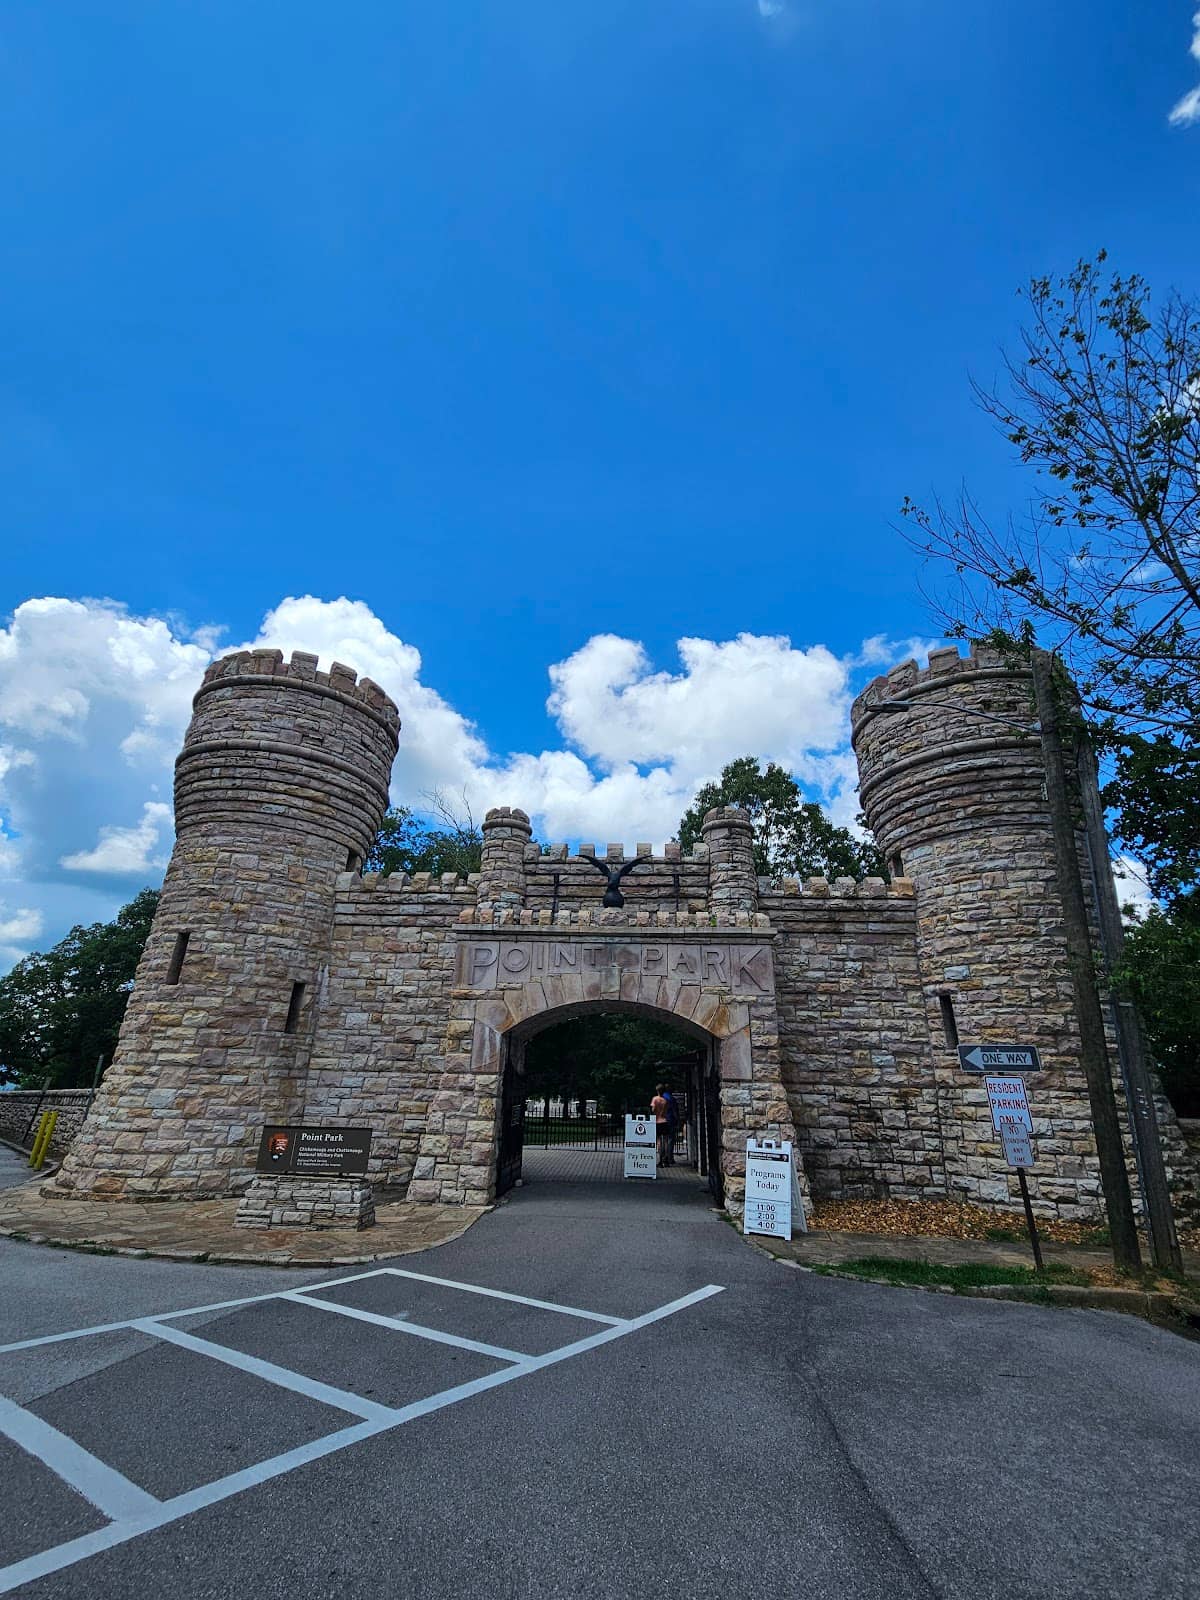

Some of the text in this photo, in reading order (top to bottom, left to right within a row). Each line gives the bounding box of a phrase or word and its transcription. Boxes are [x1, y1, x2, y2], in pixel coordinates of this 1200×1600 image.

[468, 943, 770, 992] POINT PARK
[981, 1053, 1027, 1064] ONE WAY
[988, 1083, 1021, 1094] RESIDENT
[991, 1099, 1027, 1110] PARKING
[628, 1153, 638, 1161] Pay
[750, 1168, 786, 1180] Programs
[756, 1180, 780, 1192] Today
[757, 1203, 776, 1211] 11:00
[757, 1212, 775, 1220] 2:00
[757, 1221, 775, 1229] 4:00
